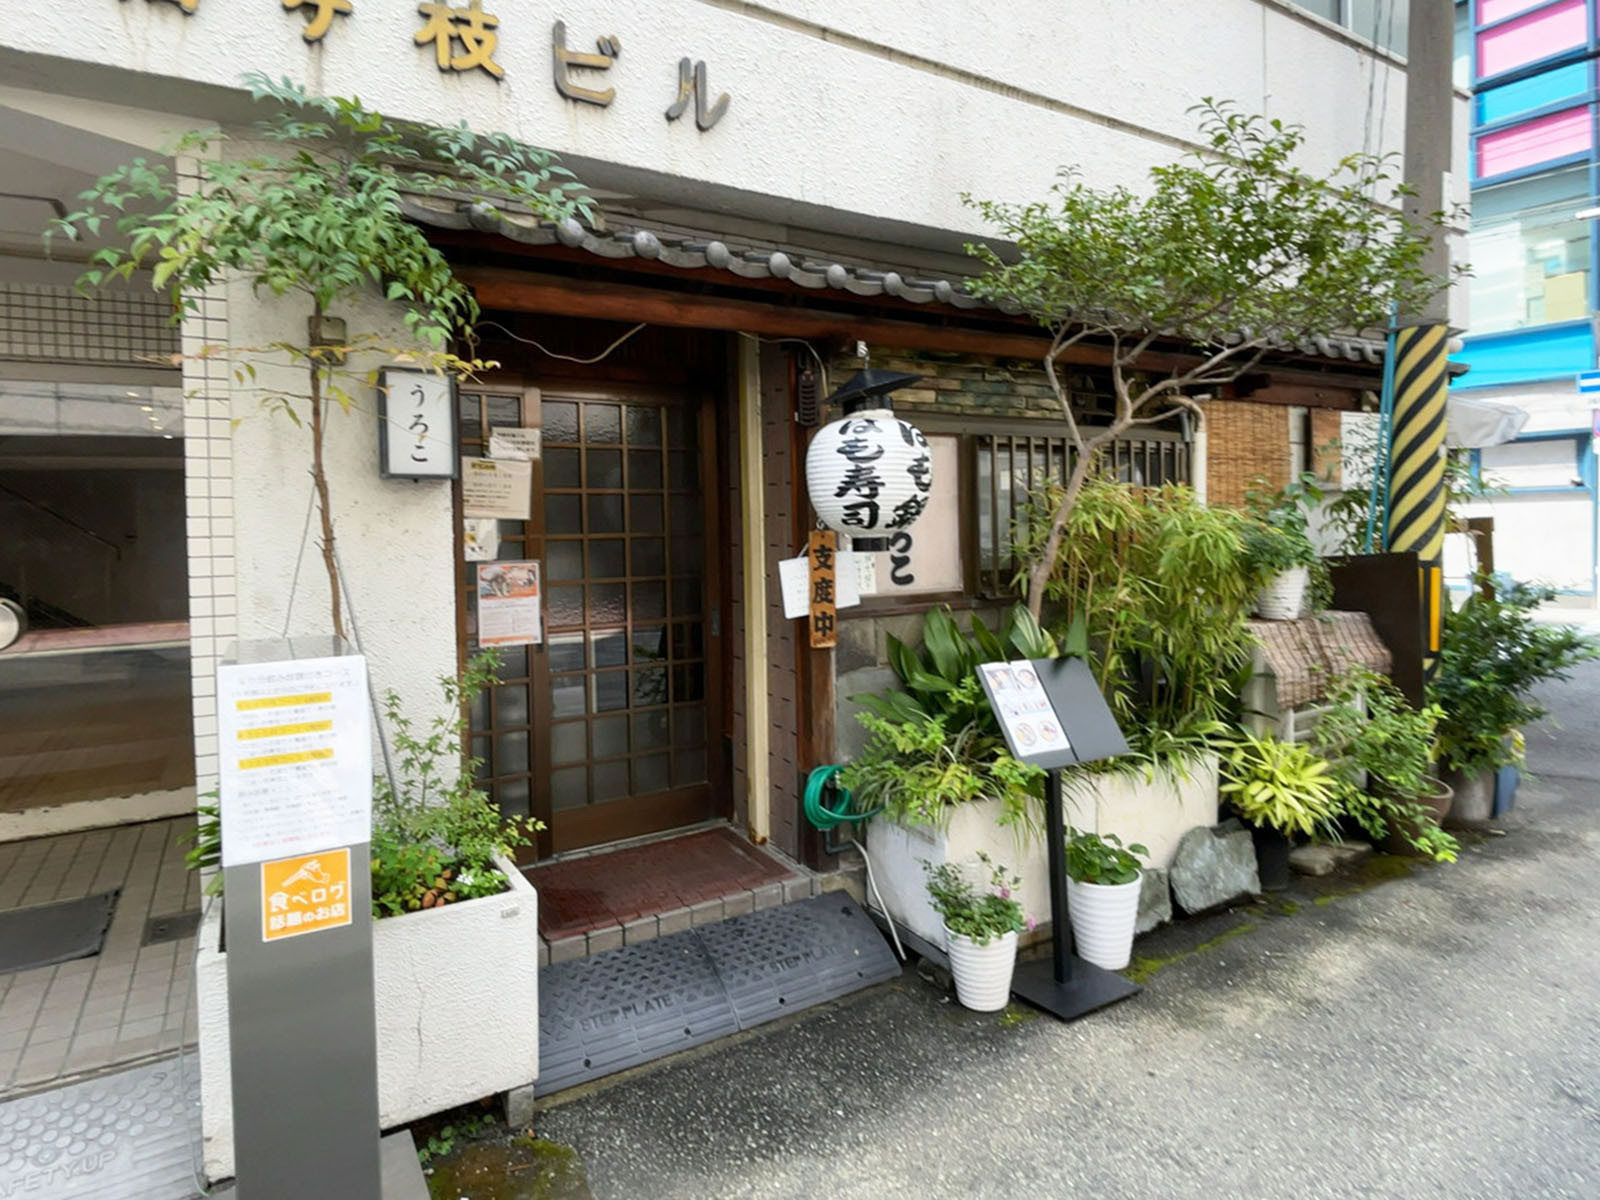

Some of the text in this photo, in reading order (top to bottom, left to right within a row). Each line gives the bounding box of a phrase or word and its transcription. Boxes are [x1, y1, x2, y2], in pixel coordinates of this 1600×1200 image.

[408, 384, 430, 463] うろこ
[812, 544, 834, 637] 支度中
[269, 881, 346, 912] 食べログ
[580, 995, 674, 1033] STEP PLATE
